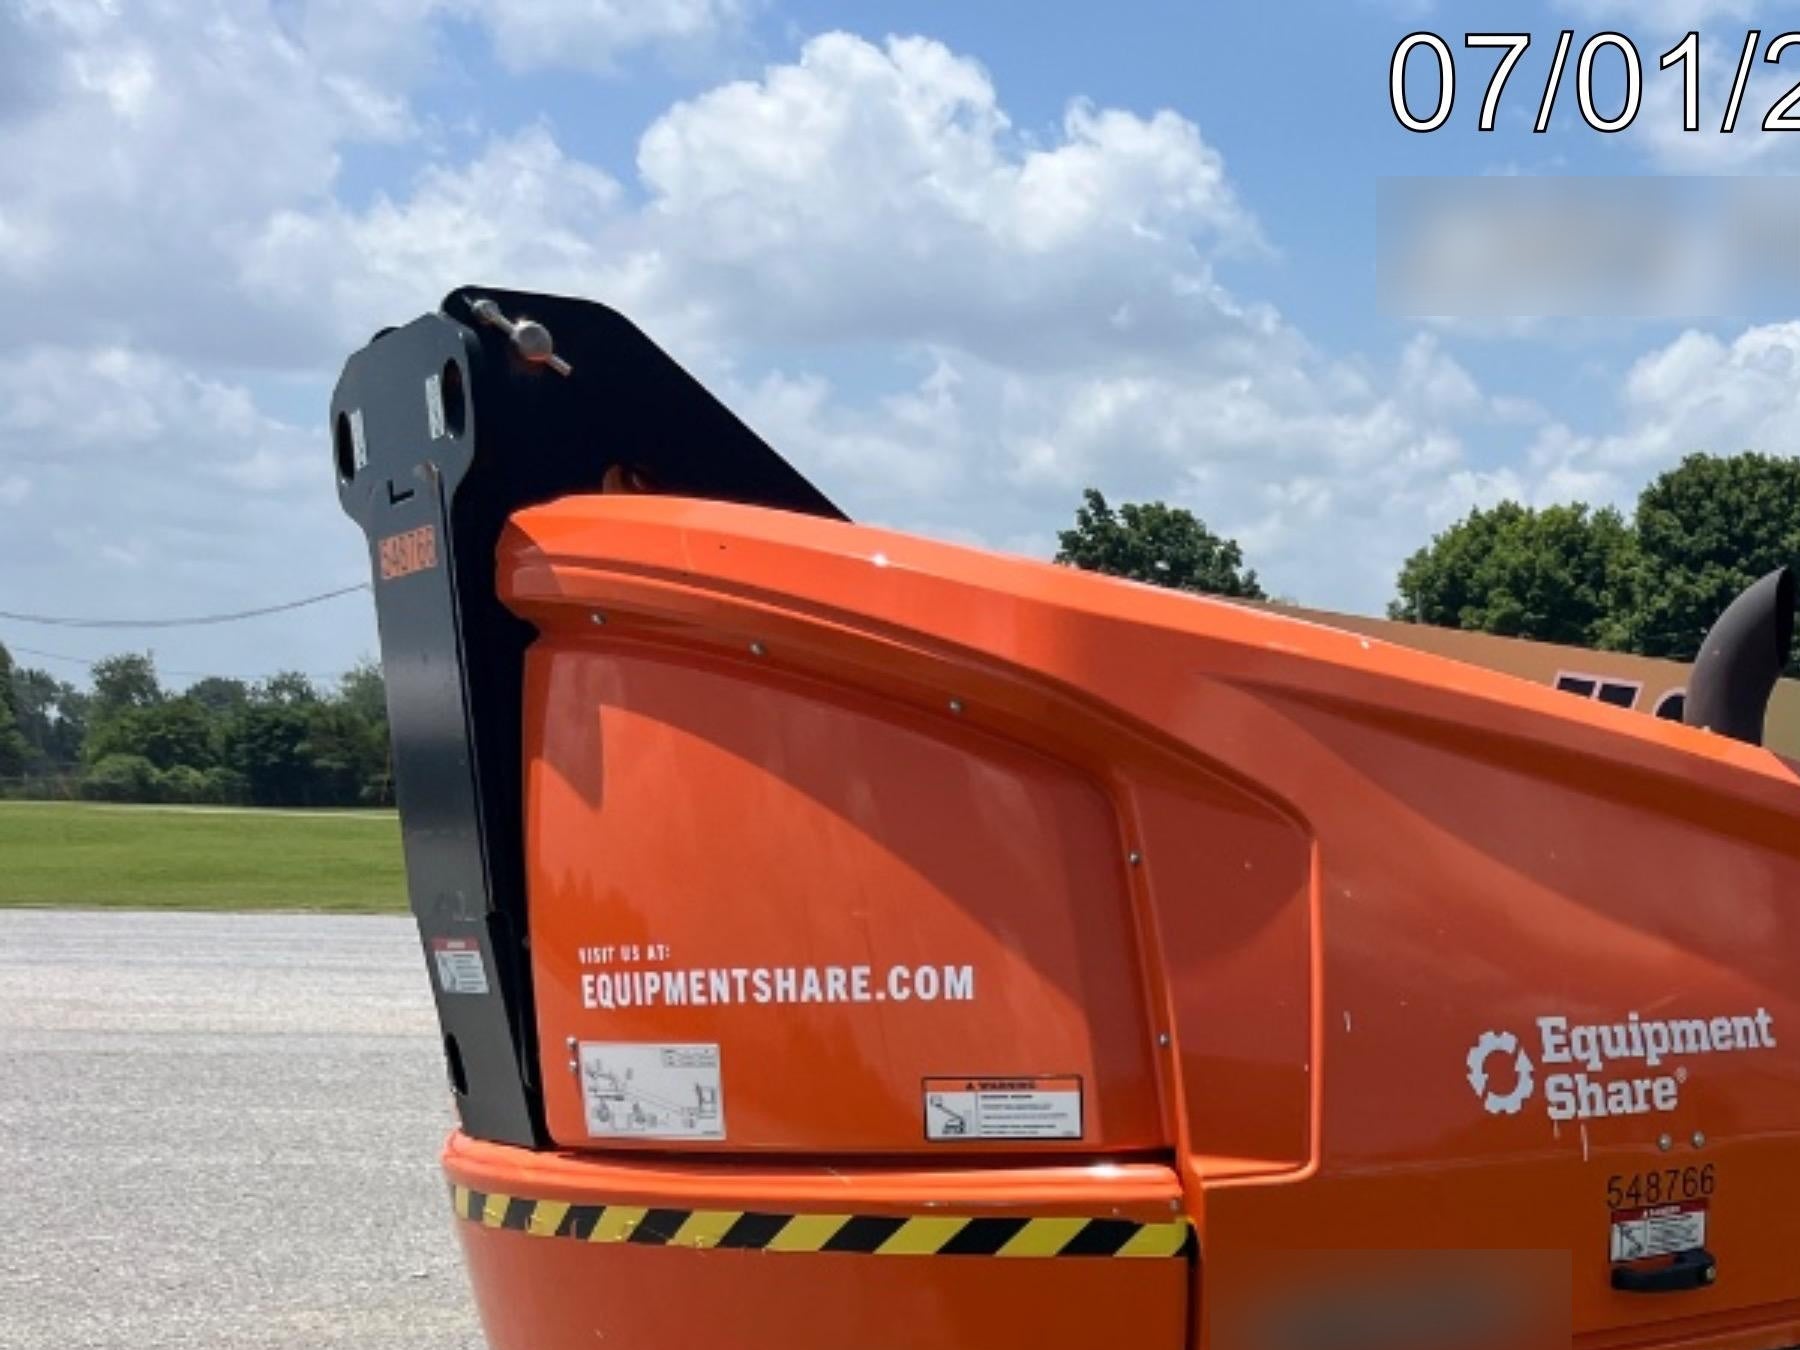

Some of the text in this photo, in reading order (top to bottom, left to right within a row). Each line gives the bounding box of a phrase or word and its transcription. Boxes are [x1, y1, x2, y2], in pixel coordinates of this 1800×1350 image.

[578, 943, 670, 964] VISIT US AT:
[581, 965, 974, 1011] EQUIPMENTSHARE.COM
[1536, 1007, 1777, 1072] Equipment
[1606, 1163, 1715, 1209] 548766
